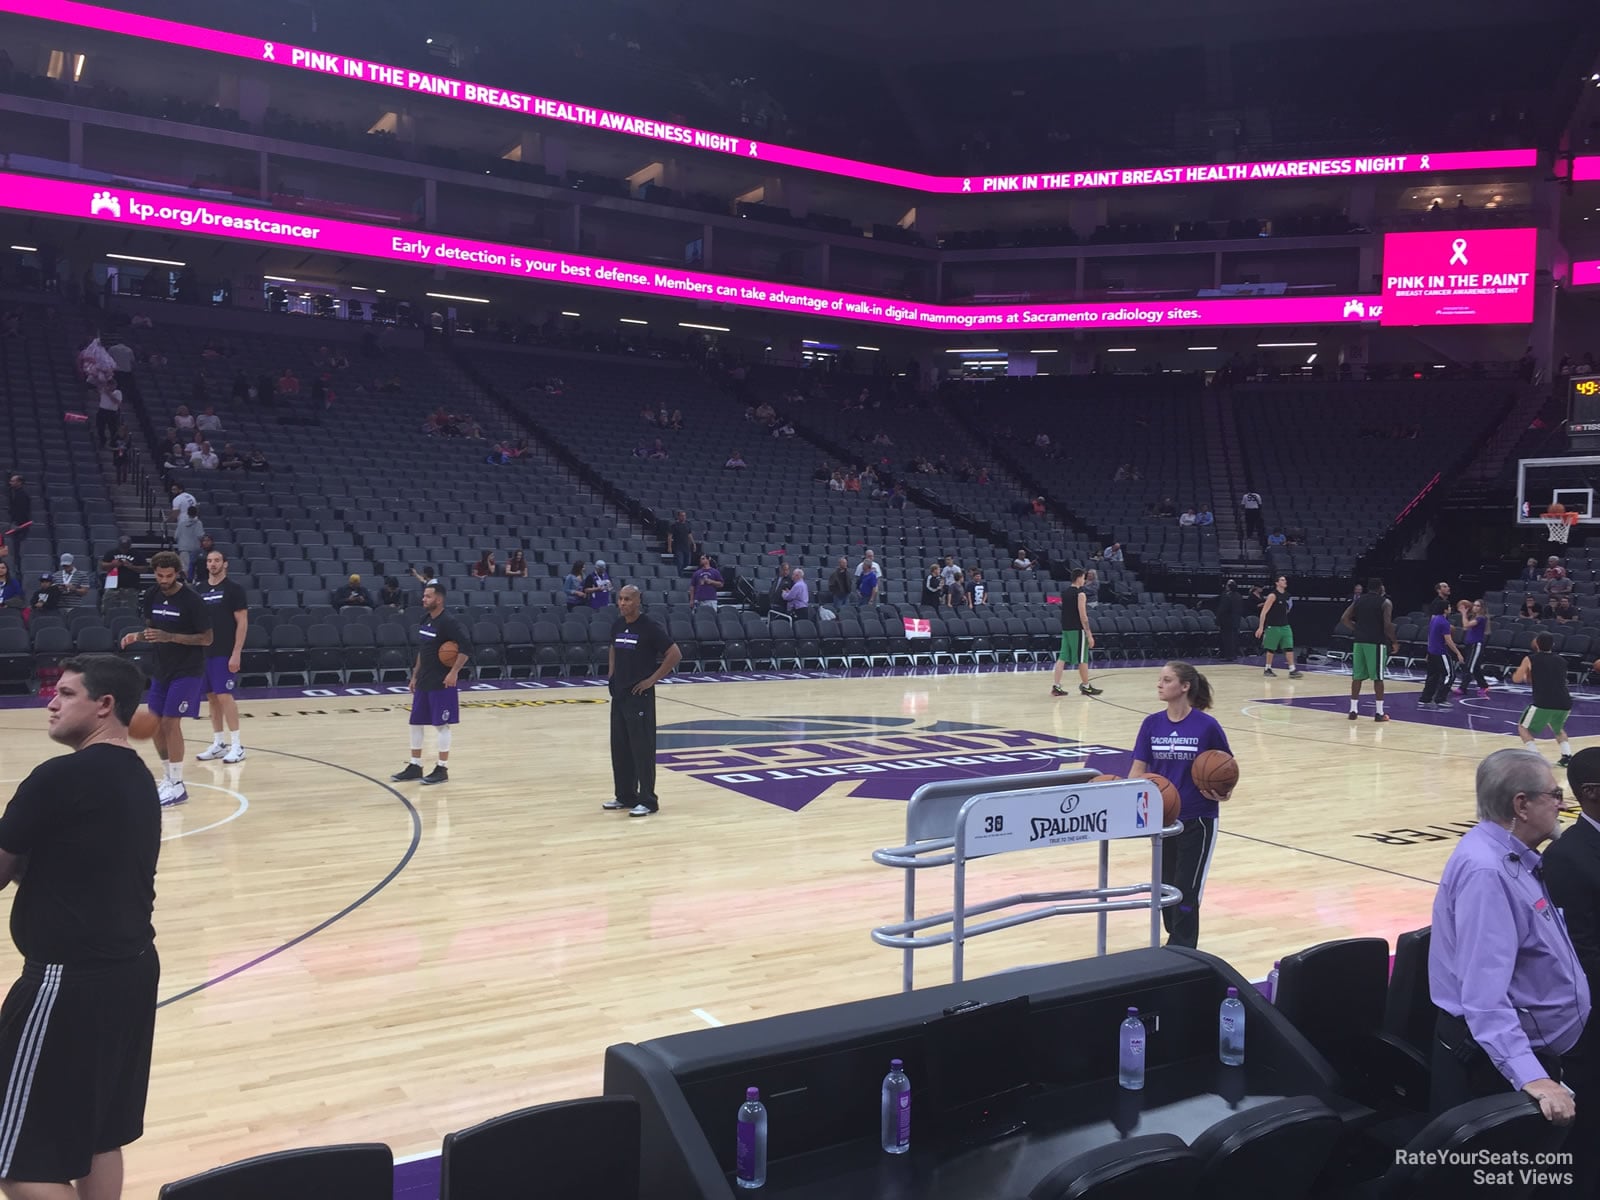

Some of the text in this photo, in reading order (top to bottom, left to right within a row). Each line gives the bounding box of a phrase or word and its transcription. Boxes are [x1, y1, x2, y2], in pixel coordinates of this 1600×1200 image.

[292, 48, 739, 153] PINK IN THE PAINT BREAST HEALTH AWARENESS NIGHT
[983, 156, 1407, 191] PINK IN THE PAINT BREAST HEALTH AWARENESS NIGHT
[129, 198, 320, 240] kp.org/breastcancer
[392, 236, 1202, 327] Early detection is your best defense. Members can take advantage of walk-in digital mammograms at Sacramento radiology sites.
[1387, 273, 1530, 289] PINK IN THE PAINT
[1576, 381, 1600, 395] 49:
[656, 730, 1084, 772] KINGS
[1151, 736, 1199, 745] SACRAMENTO
[713, 746, 1124, 784] SACRAMENTO
[1030, 809, 1108, 842] SPALDING
